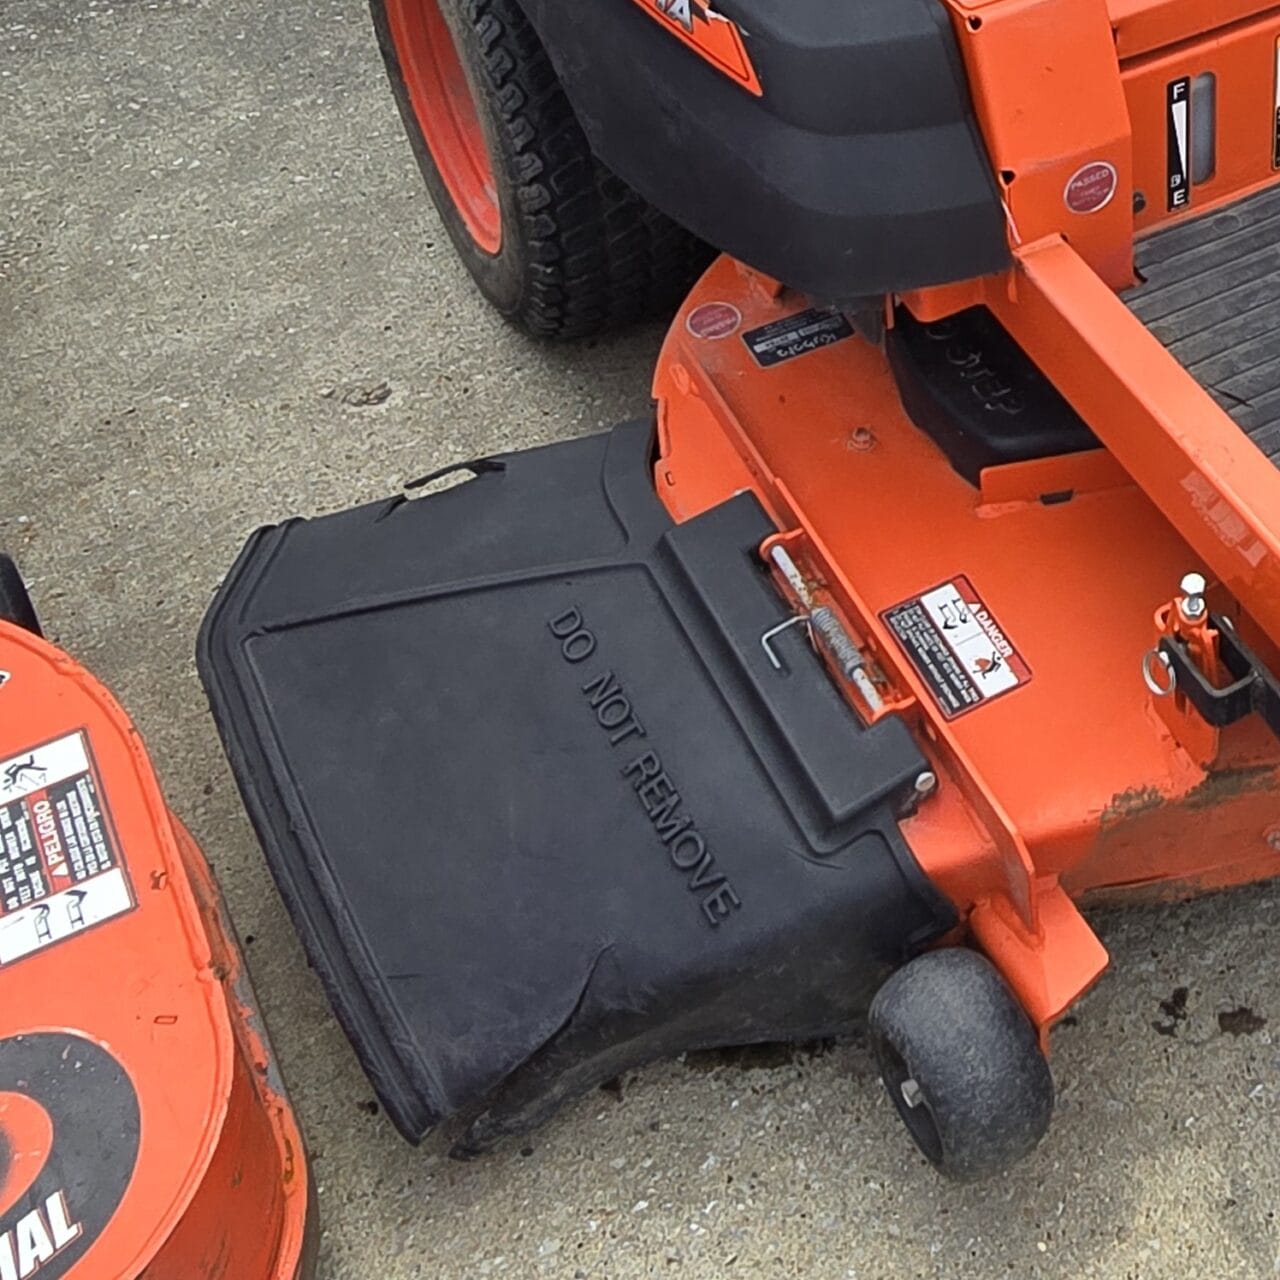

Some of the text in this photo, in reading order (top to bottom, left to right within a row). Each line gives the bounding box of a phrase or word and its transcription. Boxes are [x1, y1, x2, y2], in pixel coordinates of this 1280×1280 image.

[1173, 82, 1186, 100] F
[1173, 189, 1186, 206] E
[976, 610, 1014, 658] DANGER
[548, 606, 742, 927] DO NOT REMOVE
[33, 799, 65, 865] PELIGRO
